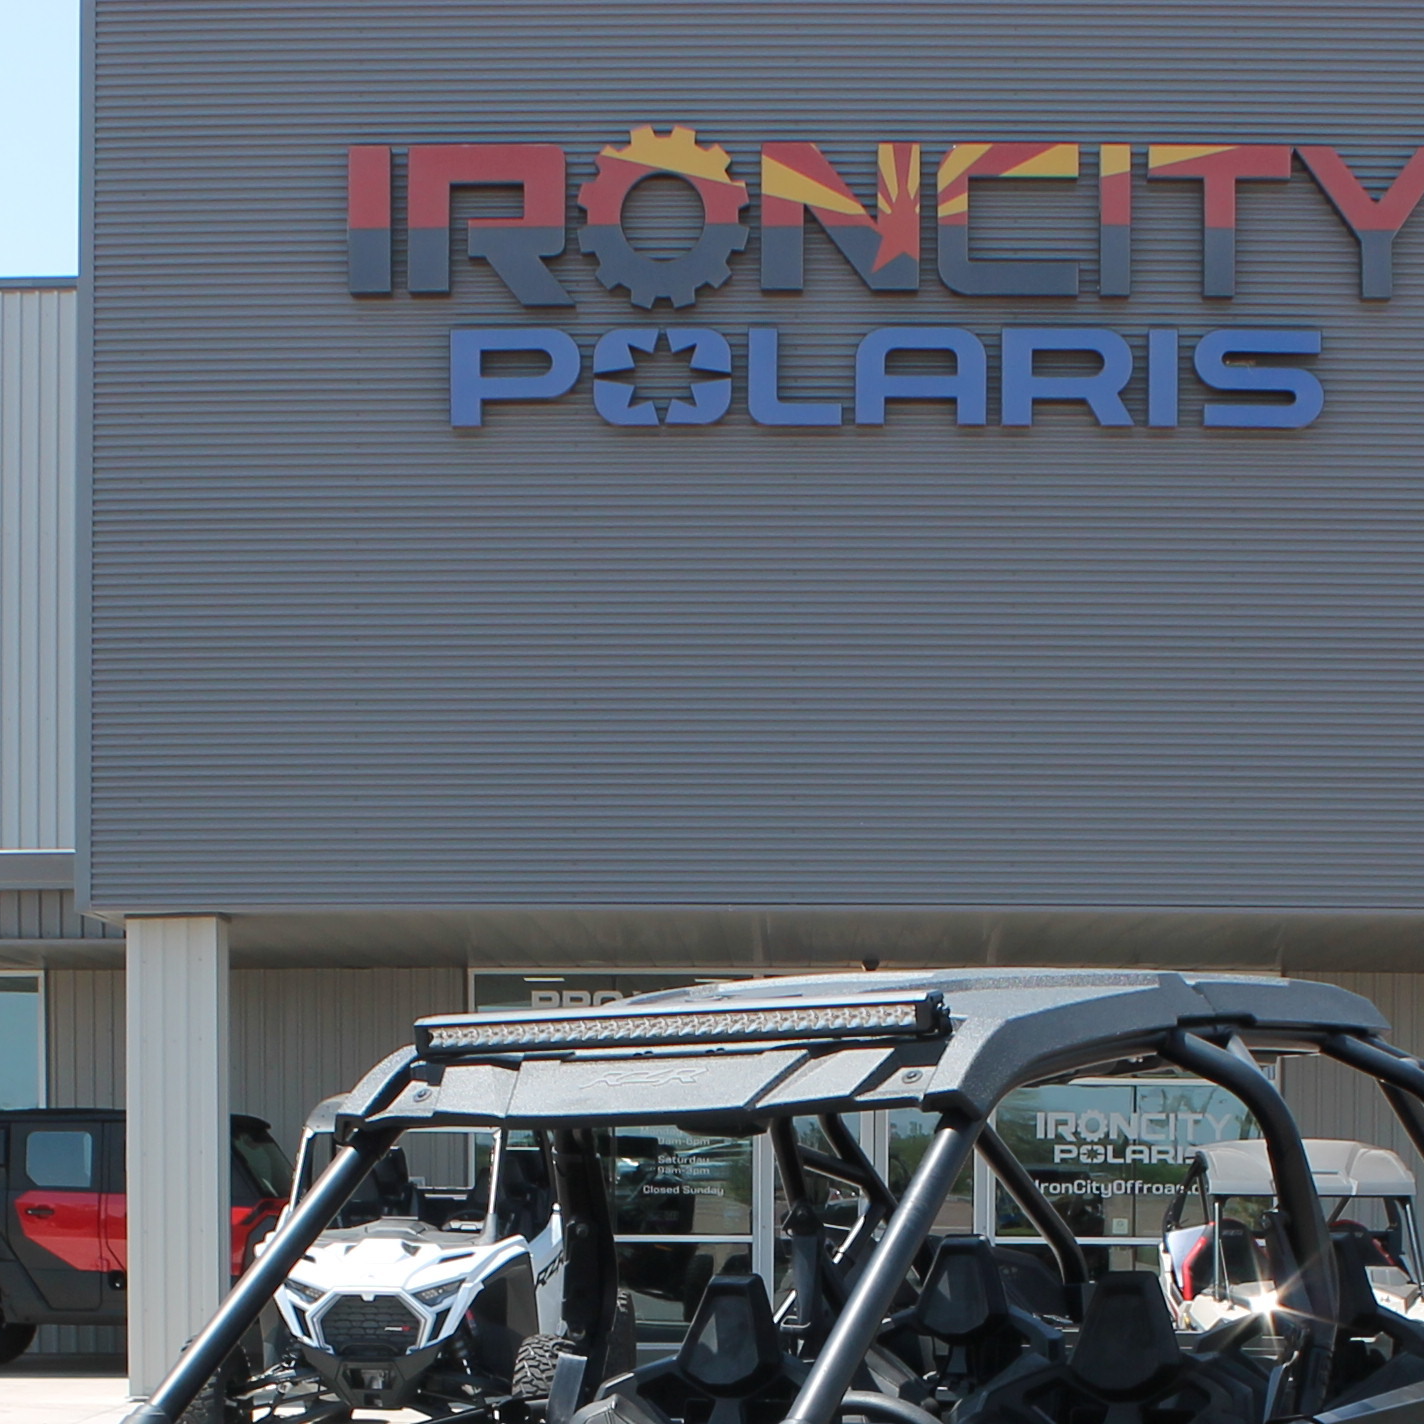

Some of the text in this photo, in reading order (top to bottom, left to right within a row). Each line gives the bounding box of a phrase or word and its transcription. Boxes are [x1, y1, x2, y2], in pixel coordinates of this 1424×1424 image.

[449, 326, 1325, 428] POLARIS
[1036, 1109, 1232, 1142] IRONCITY
[657, 1154, 710, 1166] Saturday
[642, 1184, 724, 1197] Closed Sunday
